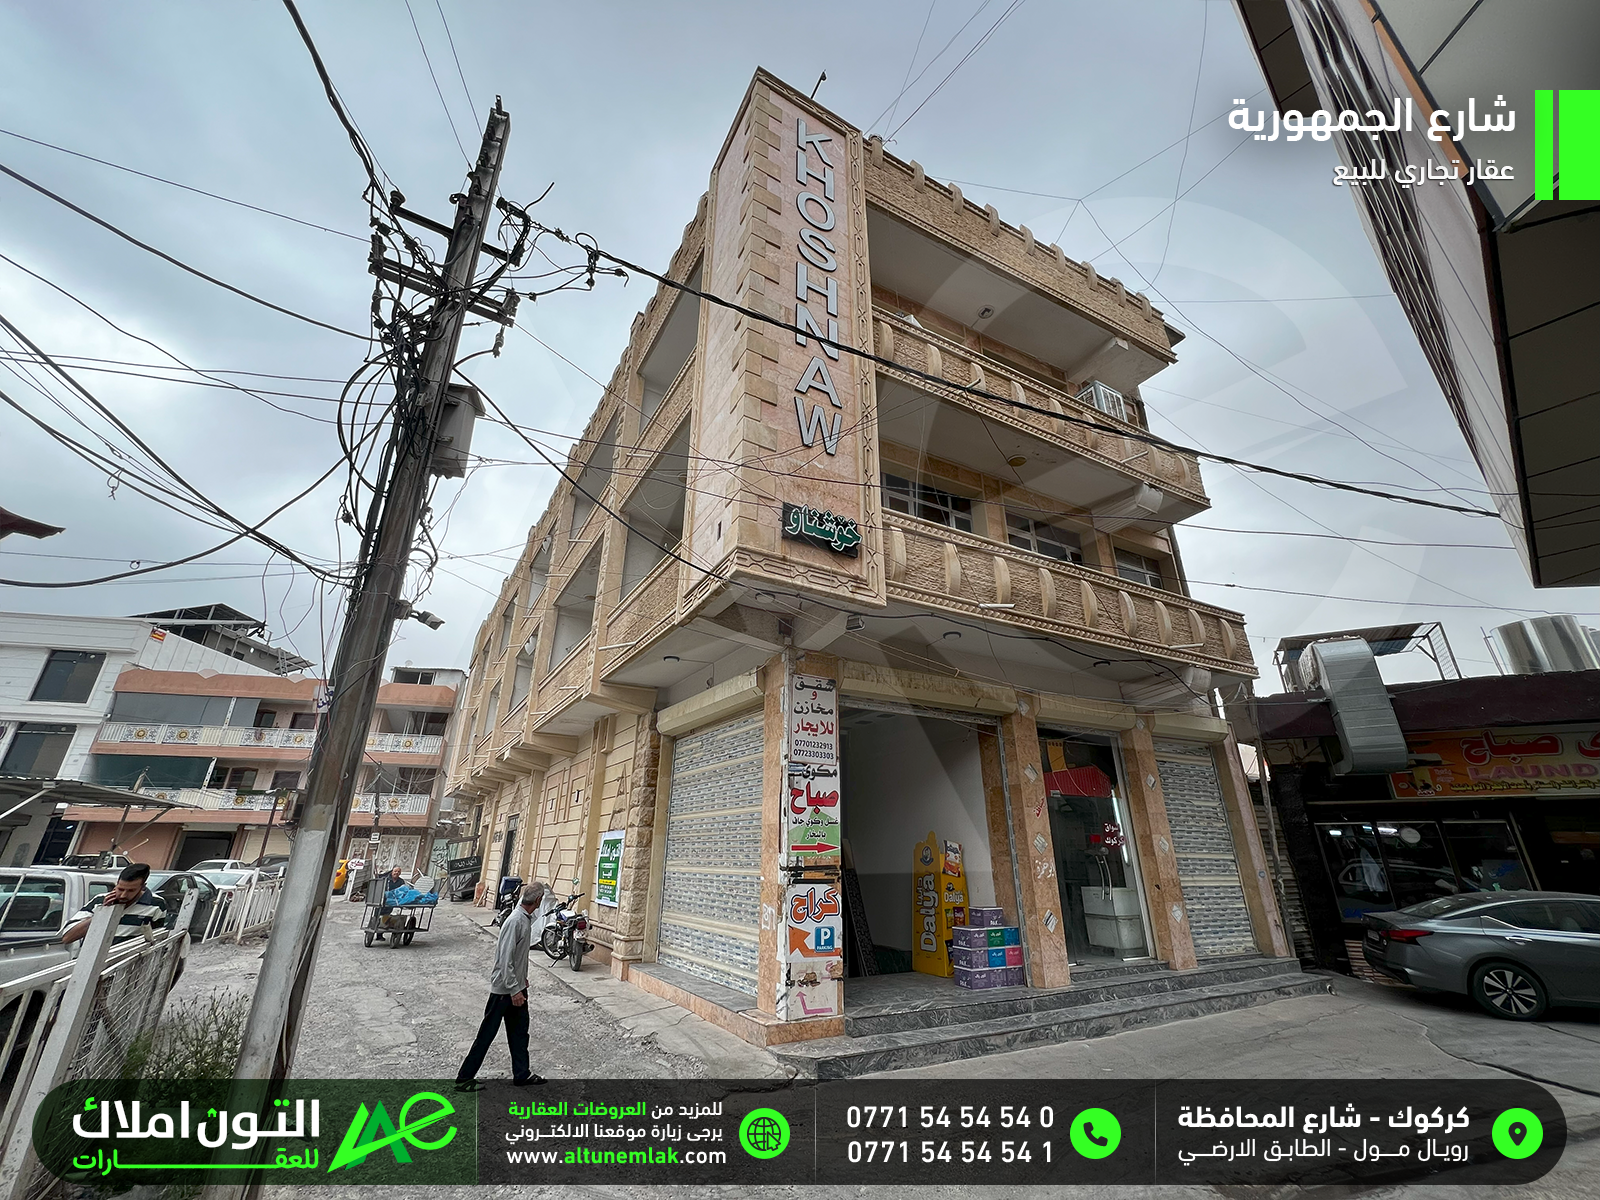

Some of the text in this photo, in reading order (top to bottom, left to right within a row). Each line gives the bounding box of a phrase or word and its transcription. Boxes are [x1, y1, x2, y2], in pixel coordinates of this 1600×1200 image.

[794, 117, 844, 457] KHOSHNAW
[794, 676, 835, 692] شقق
[810, 690, 818, 700] و
[793, 701, 834, 715] مخازن
[793, 718, 834, 737] للايجار
[794, 739, 833, 750] 07701232913
[1459, 730, 1563, 765] صباح
[793, 749, 834, 760] 07723303303
[1467, 762, 1599, 780] LAUND
[790, 781, 839, 815] صباح
[824, 817, 839, 826] غسل
[790, 887, 841, 924] كراج
[943, 891, 964, 905] Dalya
[919, 873, 939, 953] Dalya
[821, 928, 831, 946] P
